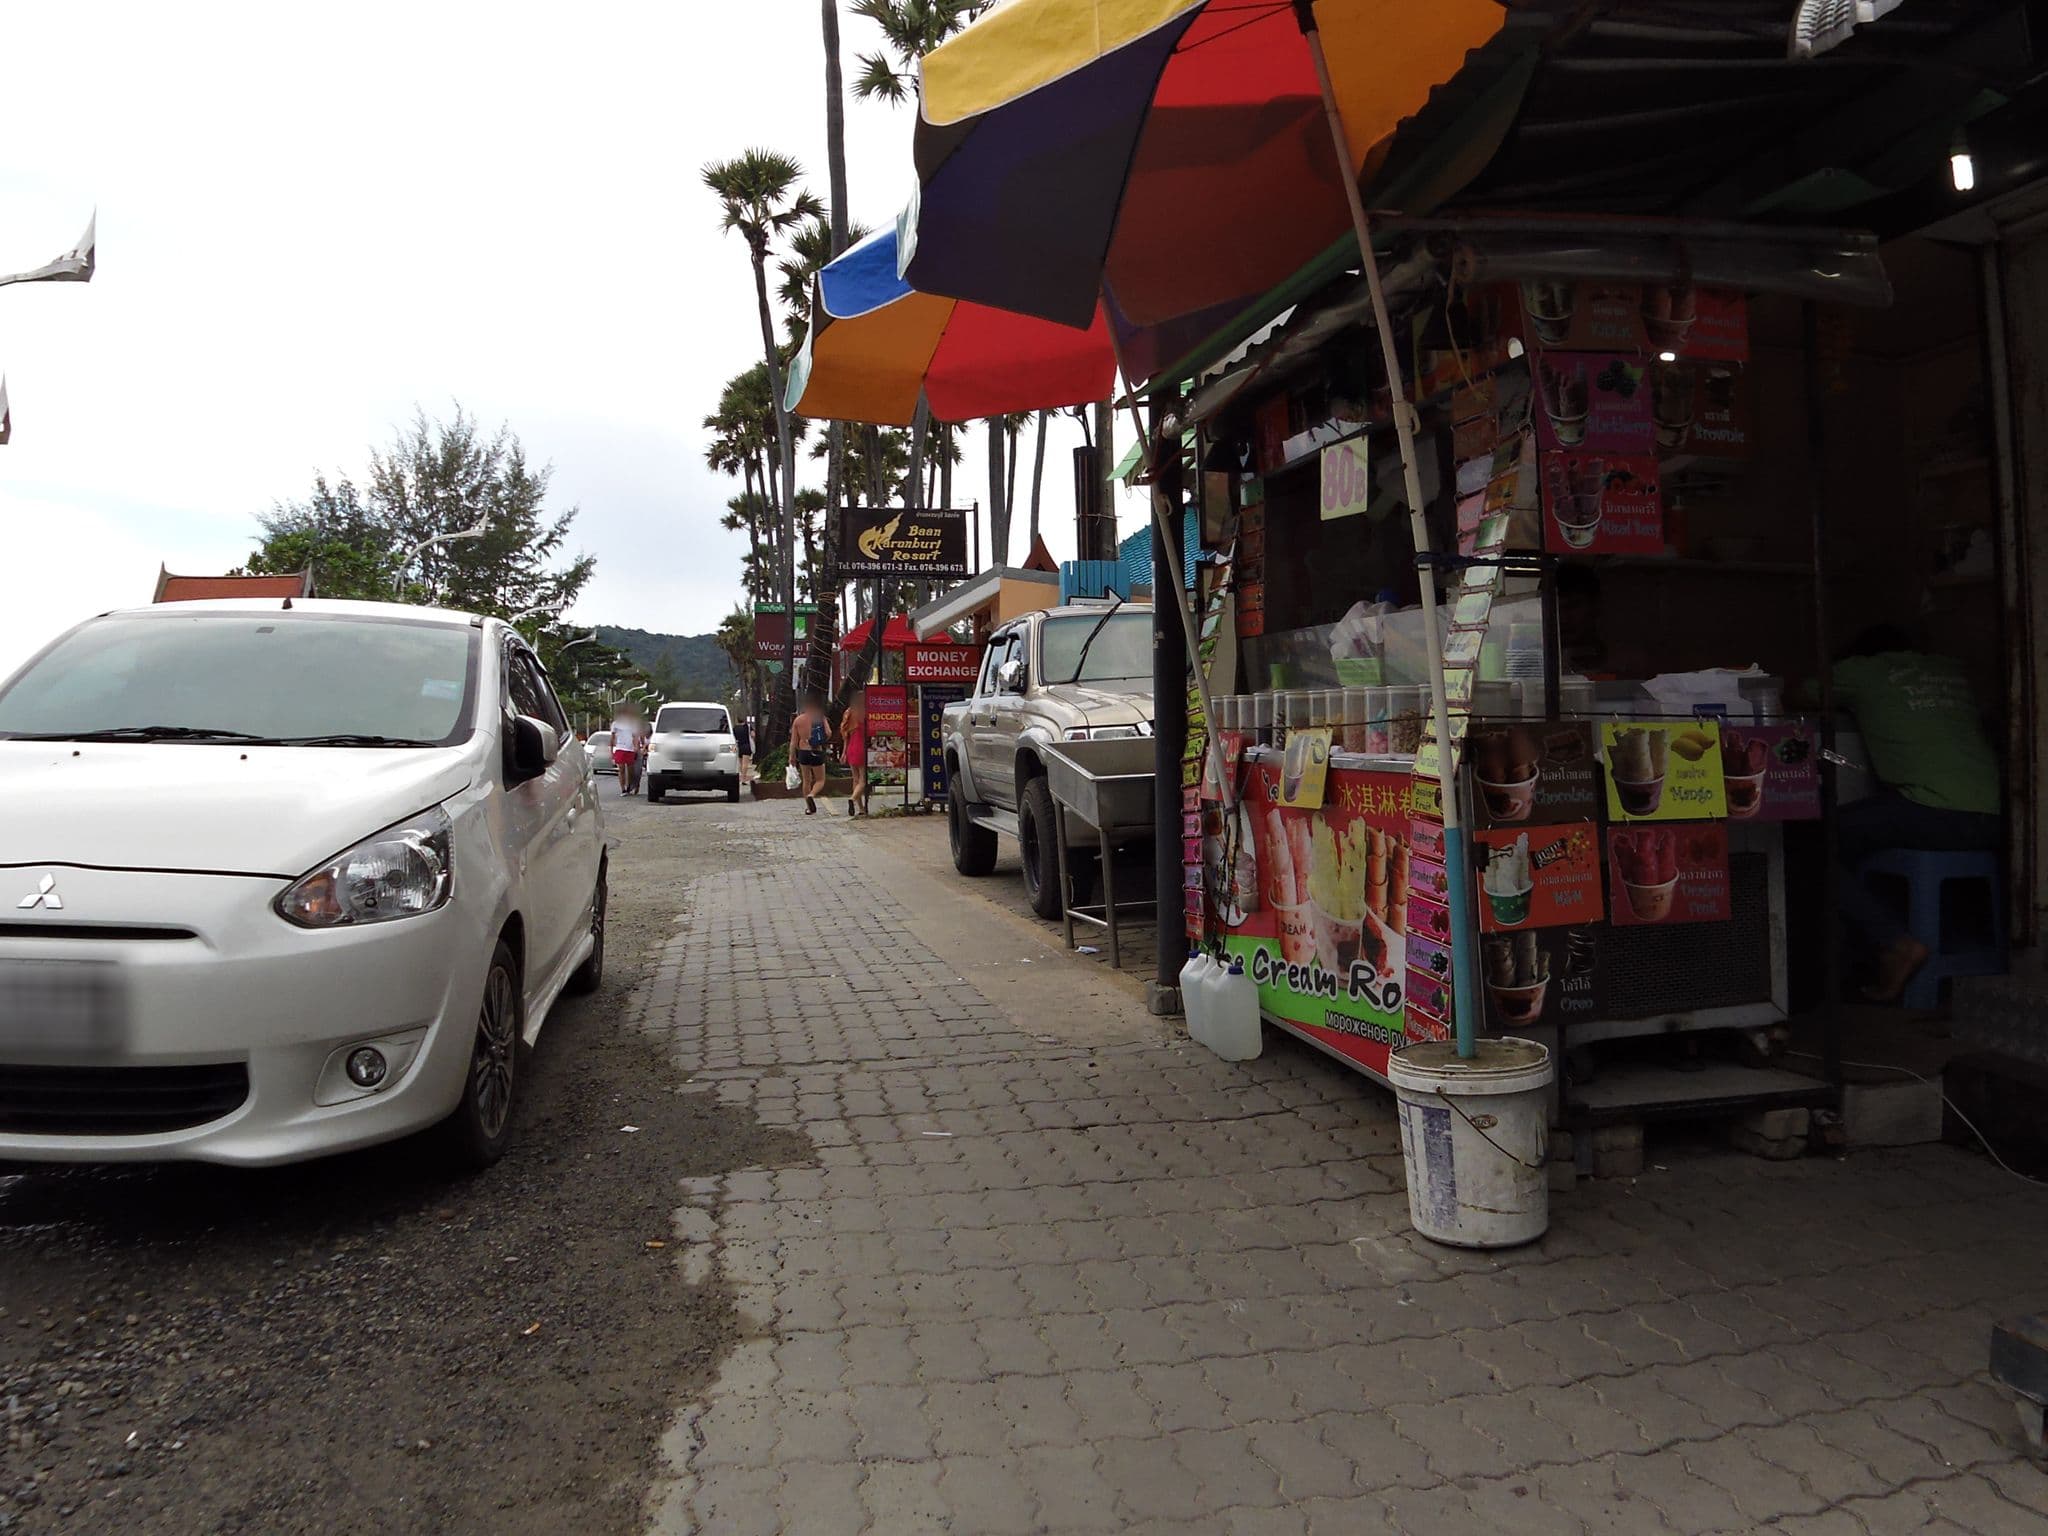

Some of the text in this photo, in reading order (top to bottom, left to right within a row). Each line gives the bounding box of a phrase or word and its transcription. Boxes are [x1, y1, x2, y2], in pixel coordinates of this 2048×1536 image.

[908, 525, 941, 536] Baan
[871, 538, 941, 550] Karonburi
[892, 550, 941, 560] Resort
[917, 652, 968, 662] MONEY
[908, 666, 978, 676] EXCHANGE
[1669, 786, 1712, 803] Mango
[1253, 948, 1336, 997] Cream
[1560, 997, 1594, 1011] Oreo
[1325, 1009, 1388, 1045] мороженое
